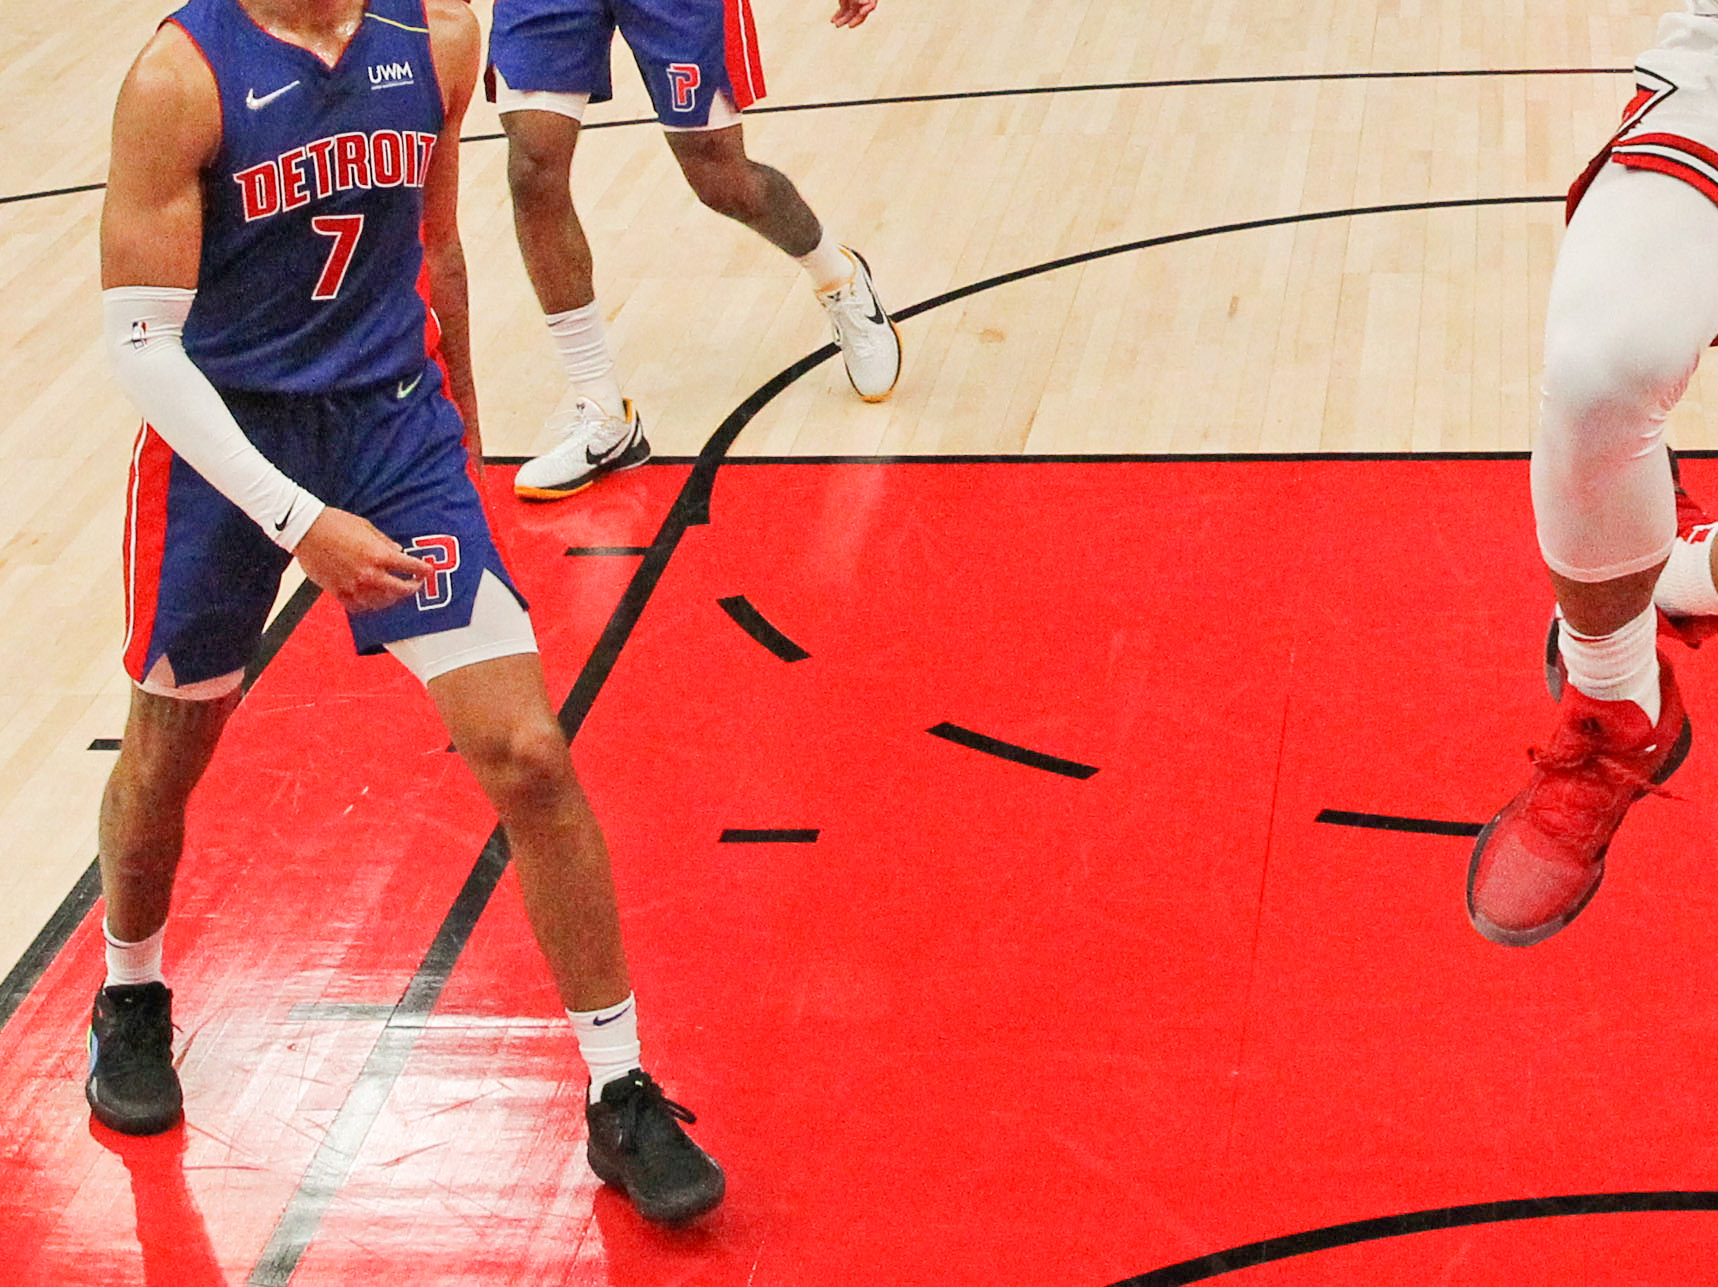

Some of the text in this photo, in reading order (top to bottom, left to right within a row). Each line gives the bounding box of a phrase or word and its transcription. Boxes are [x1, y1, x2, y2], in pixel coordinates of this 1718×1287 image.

[368, 62, 413, 83] UWM
[232, 129, 437, 222] DETROIT
[311, 214, 364, 300] 7
